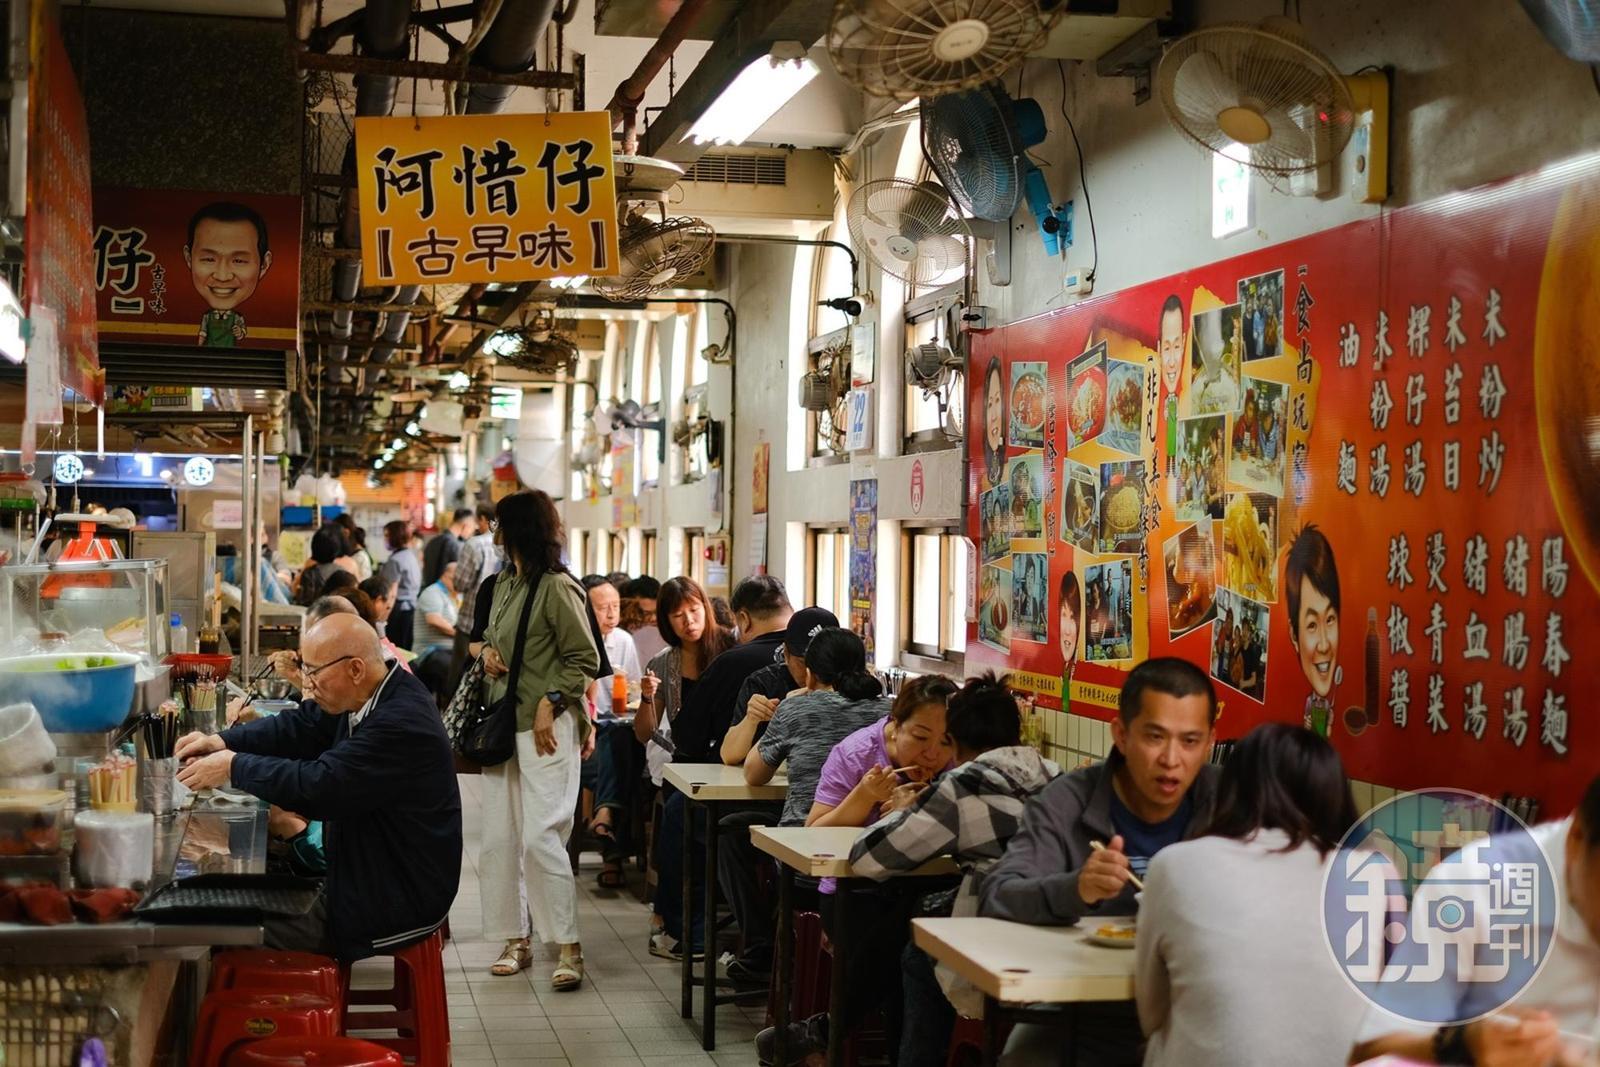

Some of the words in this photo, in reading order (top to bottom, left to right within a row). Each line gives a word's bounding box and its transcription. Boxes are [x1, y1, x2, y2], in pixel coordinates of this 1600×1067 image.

[375, 140, 605, 219] 阿惜仔
[148, 263, 167, 315] 古早味
[1369, 311, 1394, 497] 米粉湯
[1403, 305, 1431, 496] 粿仔湯
[1443, 296, 1466, 491] 米苔目
[1478, 288, 1507, 494] 米粉炒
[1386, 534, 1414, 728] 辣椒醬
[1424, 532, 1448, 734] 燙青菜
[1541, 536, 1570, 754] 陽春麵
